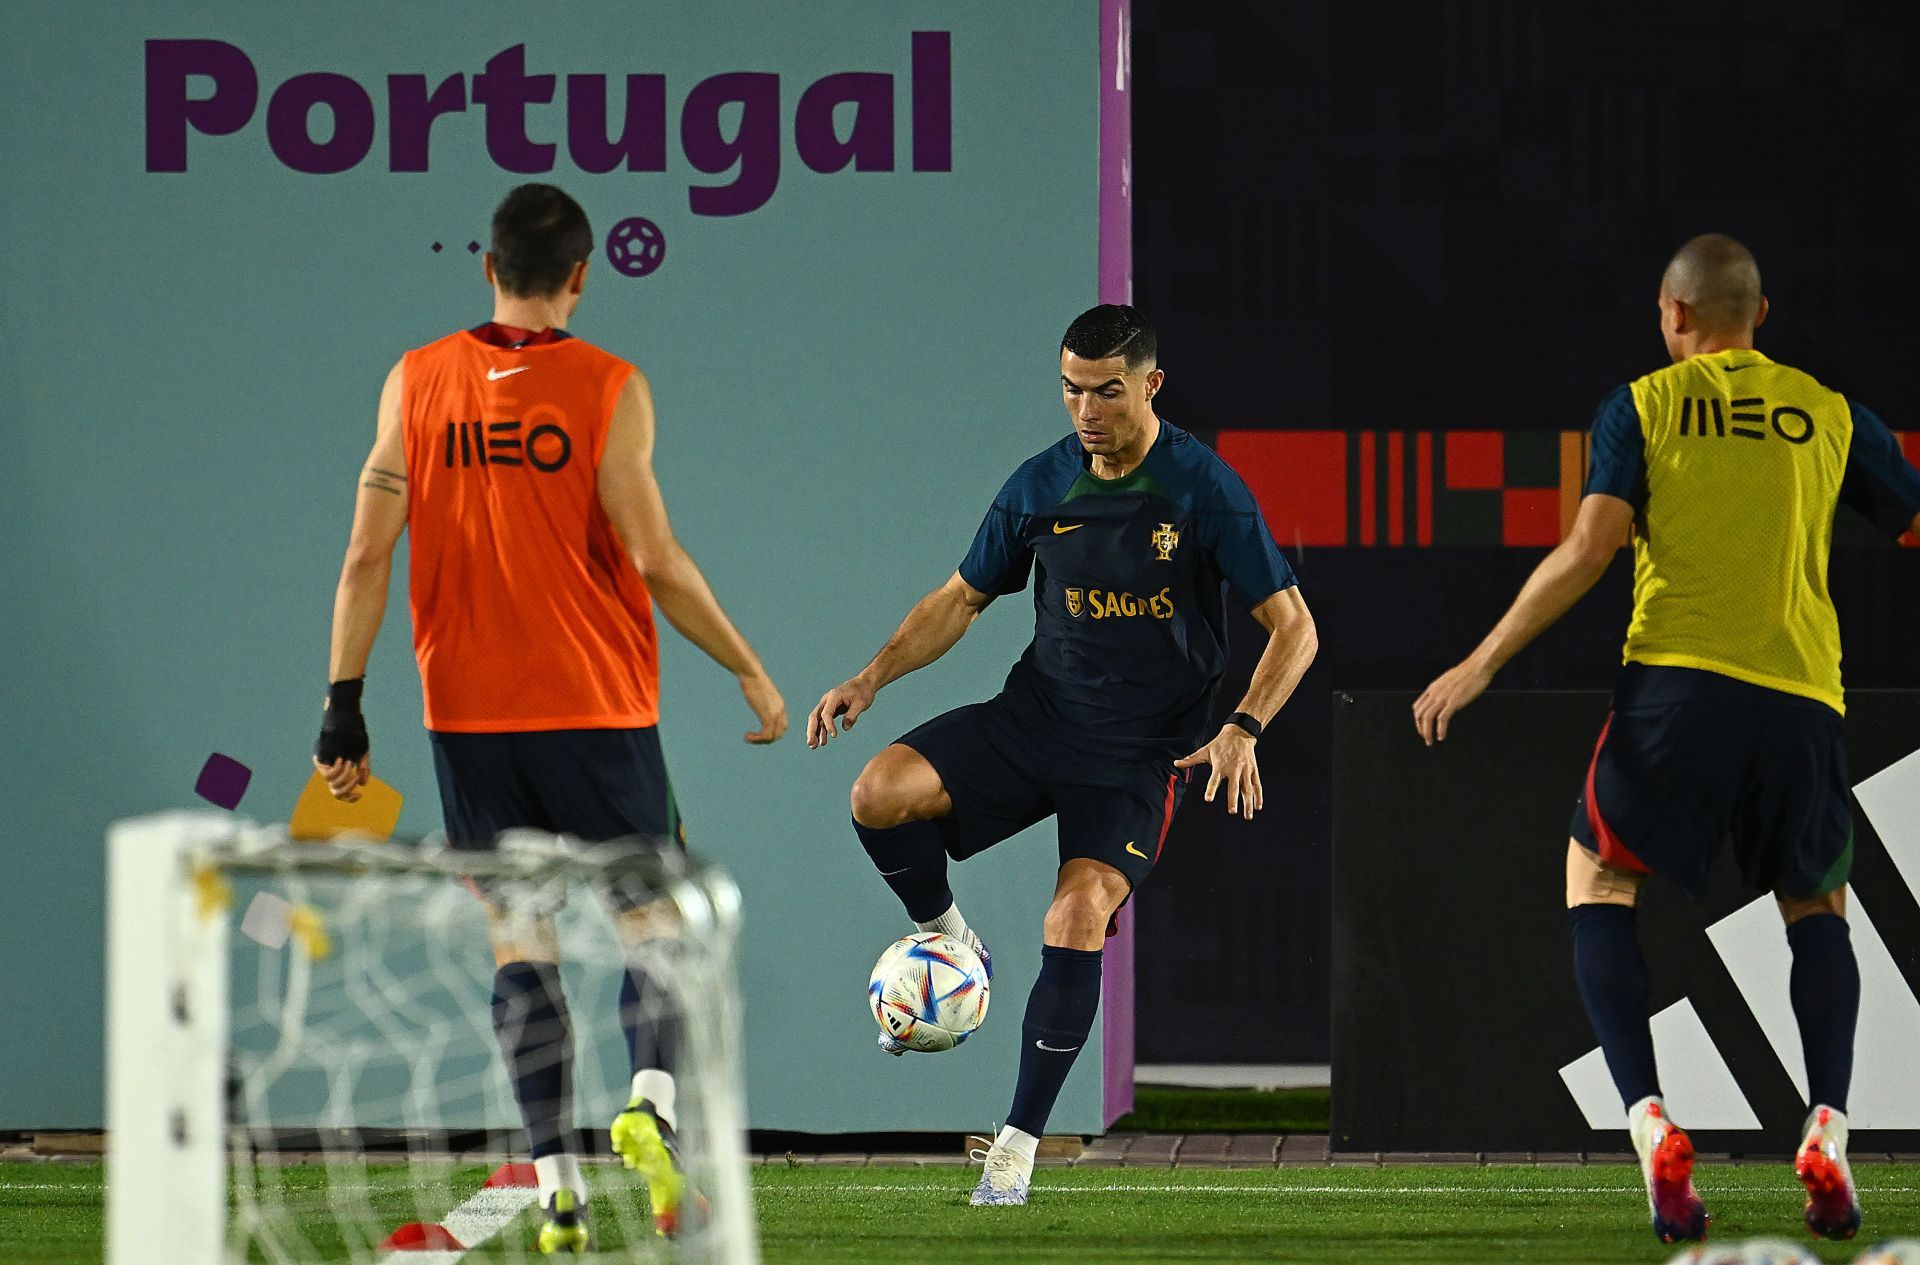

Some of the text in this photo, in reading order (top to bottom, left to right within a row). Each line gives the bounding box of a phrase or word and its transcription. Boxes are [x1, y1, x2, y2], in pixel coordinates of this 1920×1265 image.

[145, 31, 952, 217] Portugal
[445, 421, 571, 473] MEO
[1680, 397, 1815, 445] MEO
